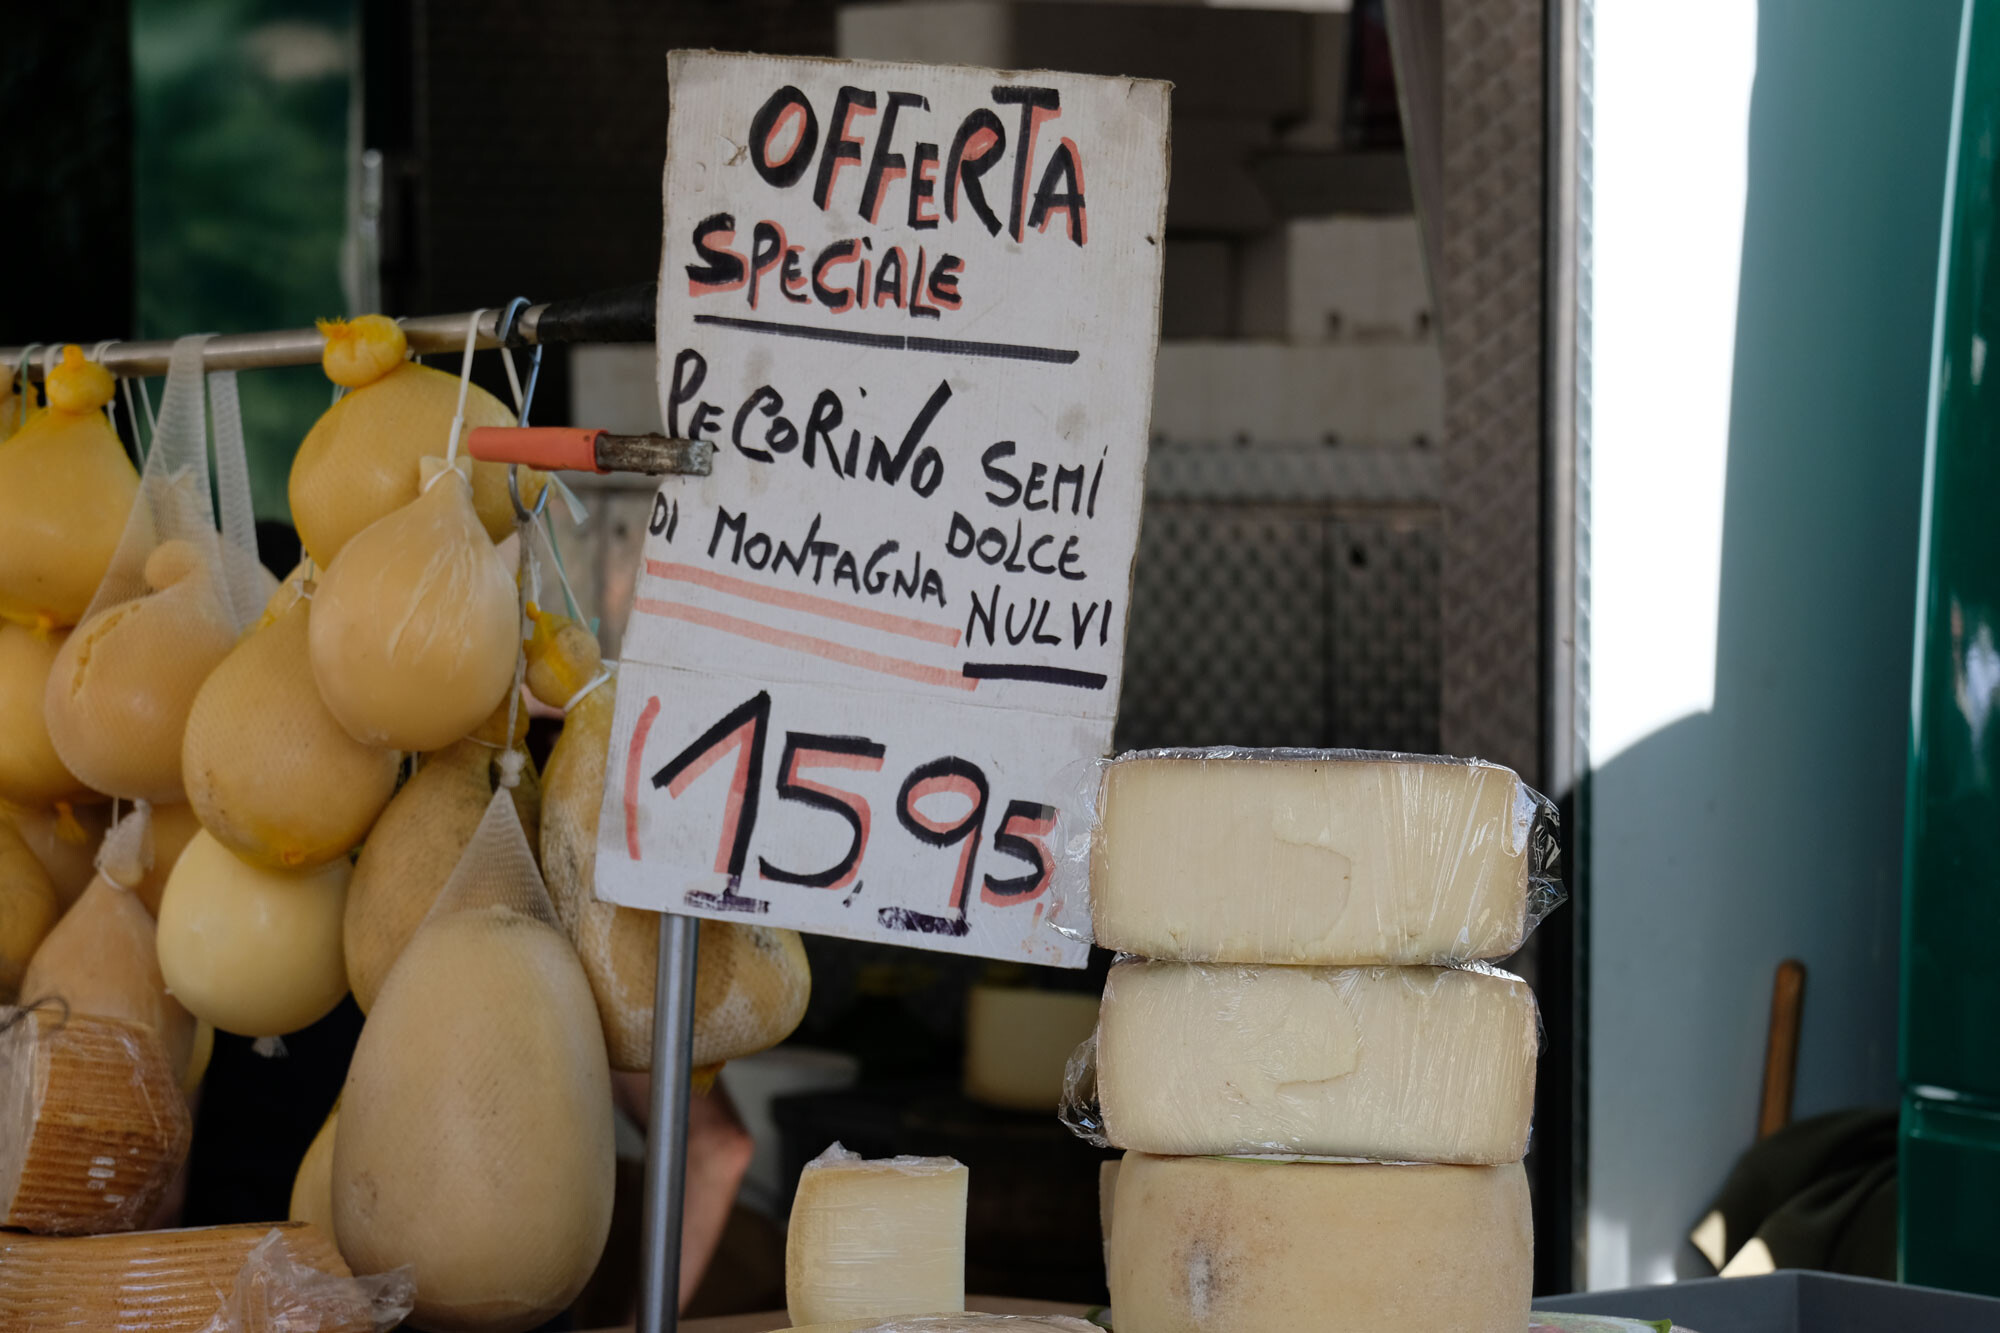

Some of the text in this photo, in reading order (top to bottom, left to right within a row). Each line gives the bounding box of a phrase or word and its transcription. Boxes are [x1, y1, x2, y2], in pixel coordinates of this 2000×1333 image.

[748, 84, 1089, 248] OFFERTA
[649, 491, 947, 608] DI MONTAGNA
[945, 511, 1087, 580] DOLCE
[965, 584, 1112, 650] NULVI
